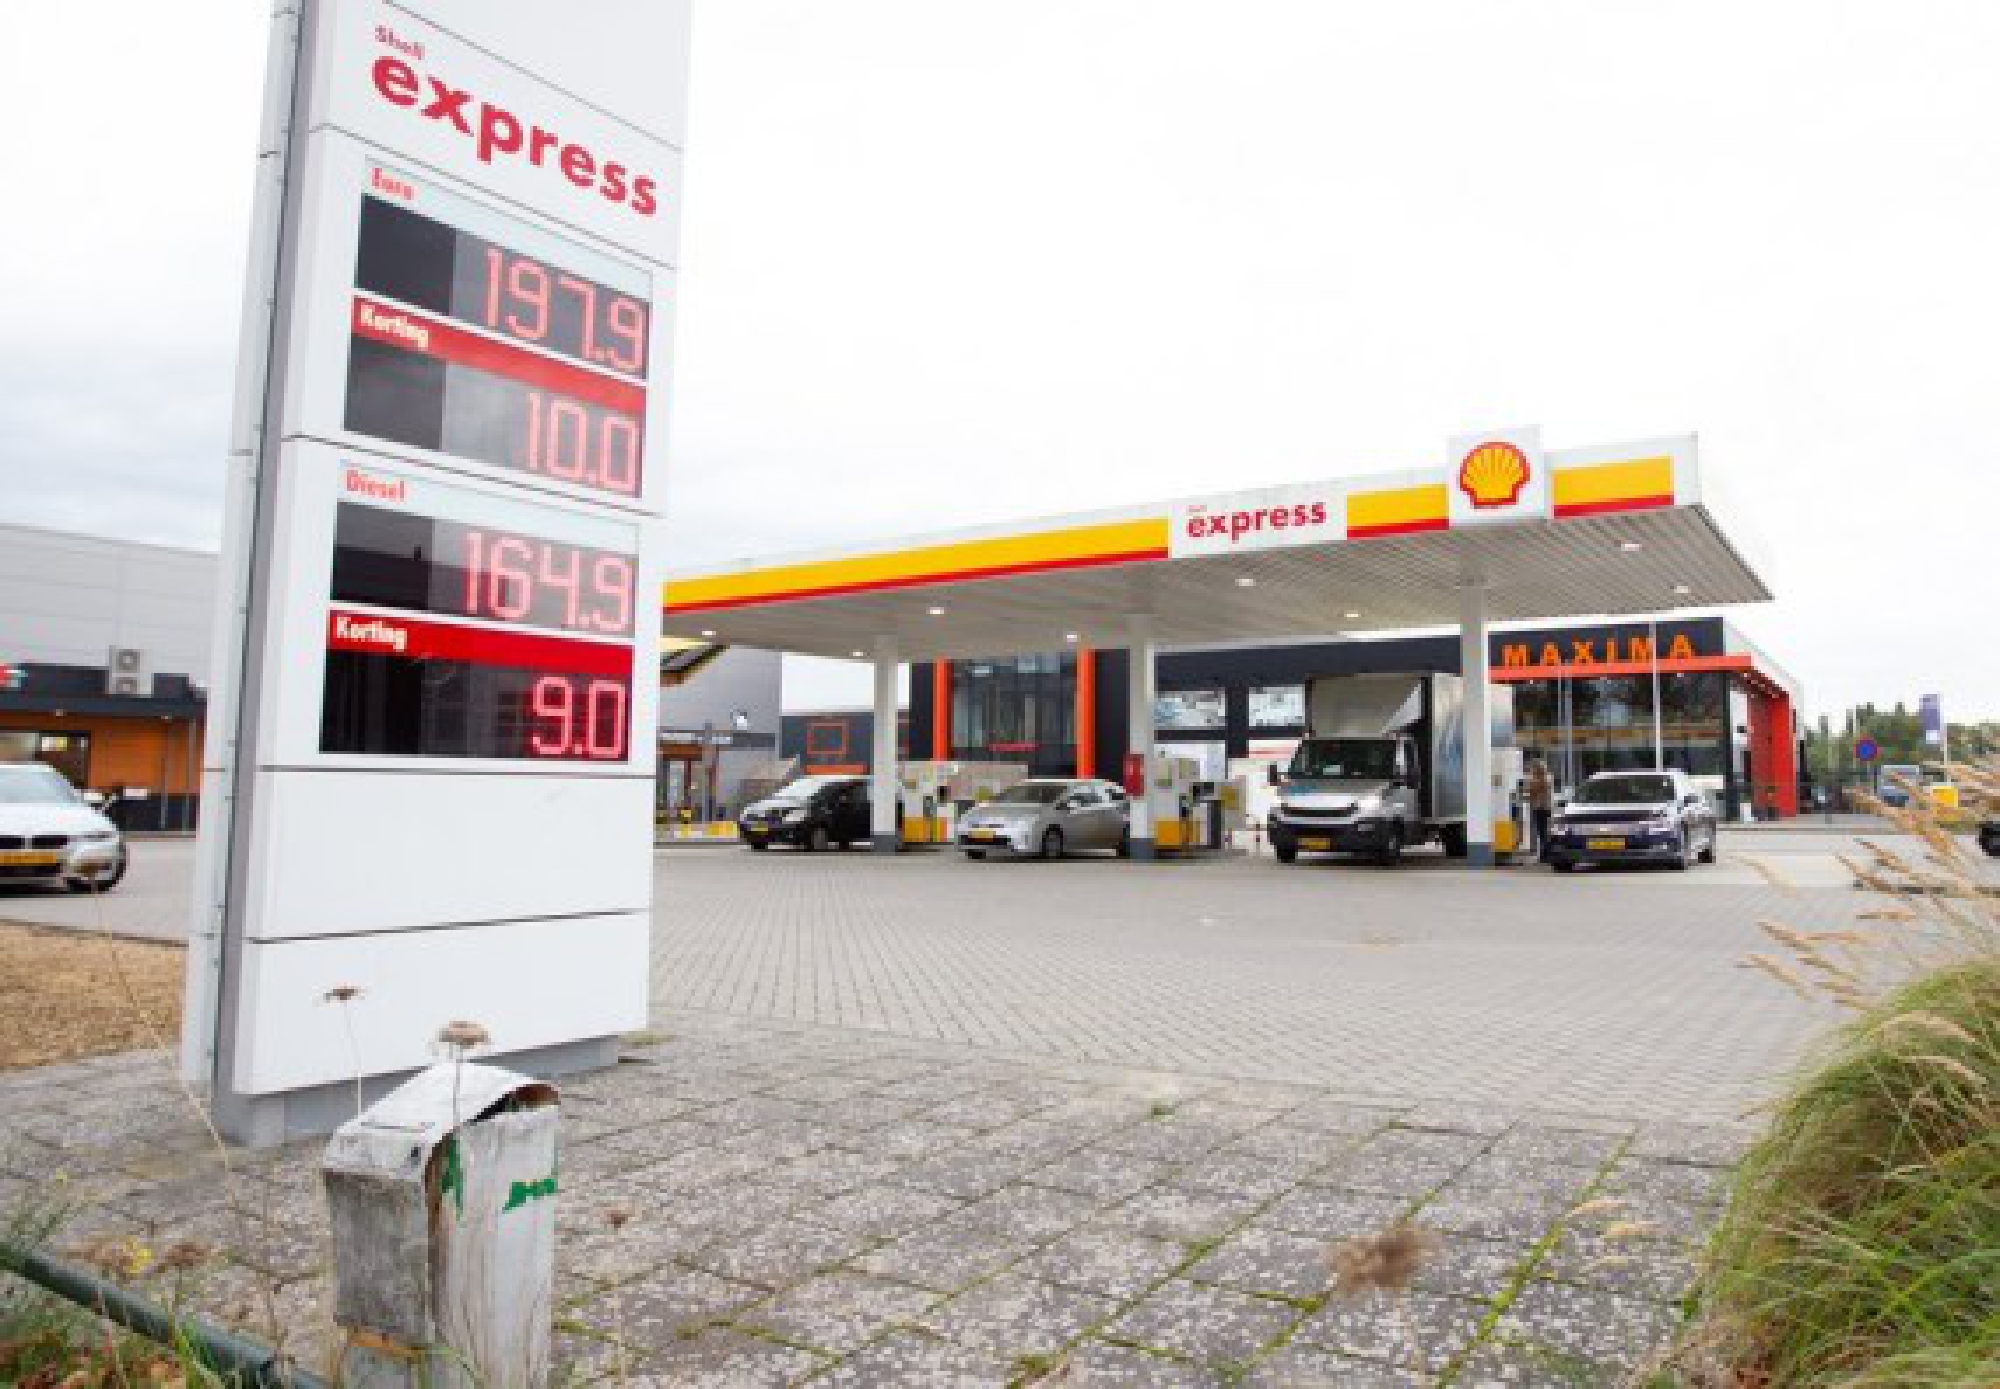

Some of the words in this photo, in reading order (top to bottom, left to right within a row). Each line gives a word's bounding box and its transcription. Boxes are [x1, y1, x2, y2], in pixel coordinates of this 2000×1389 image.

[372, 55, 657, 215] express
[360, 307, 429, 349] Korting
[484, 248, 643, 372] 197.9
[528, 392, 640, 495] 10.0
[346, 469, 406, 502] Diesel
[1187, 501, 1327, 542] express
[464, 532, 632, 631] 164.9
[335, 616, 407, 651] Korting
[1502, 633, 1696, 668] MAXIMA
[532, 676, 627, 758] 9.0
